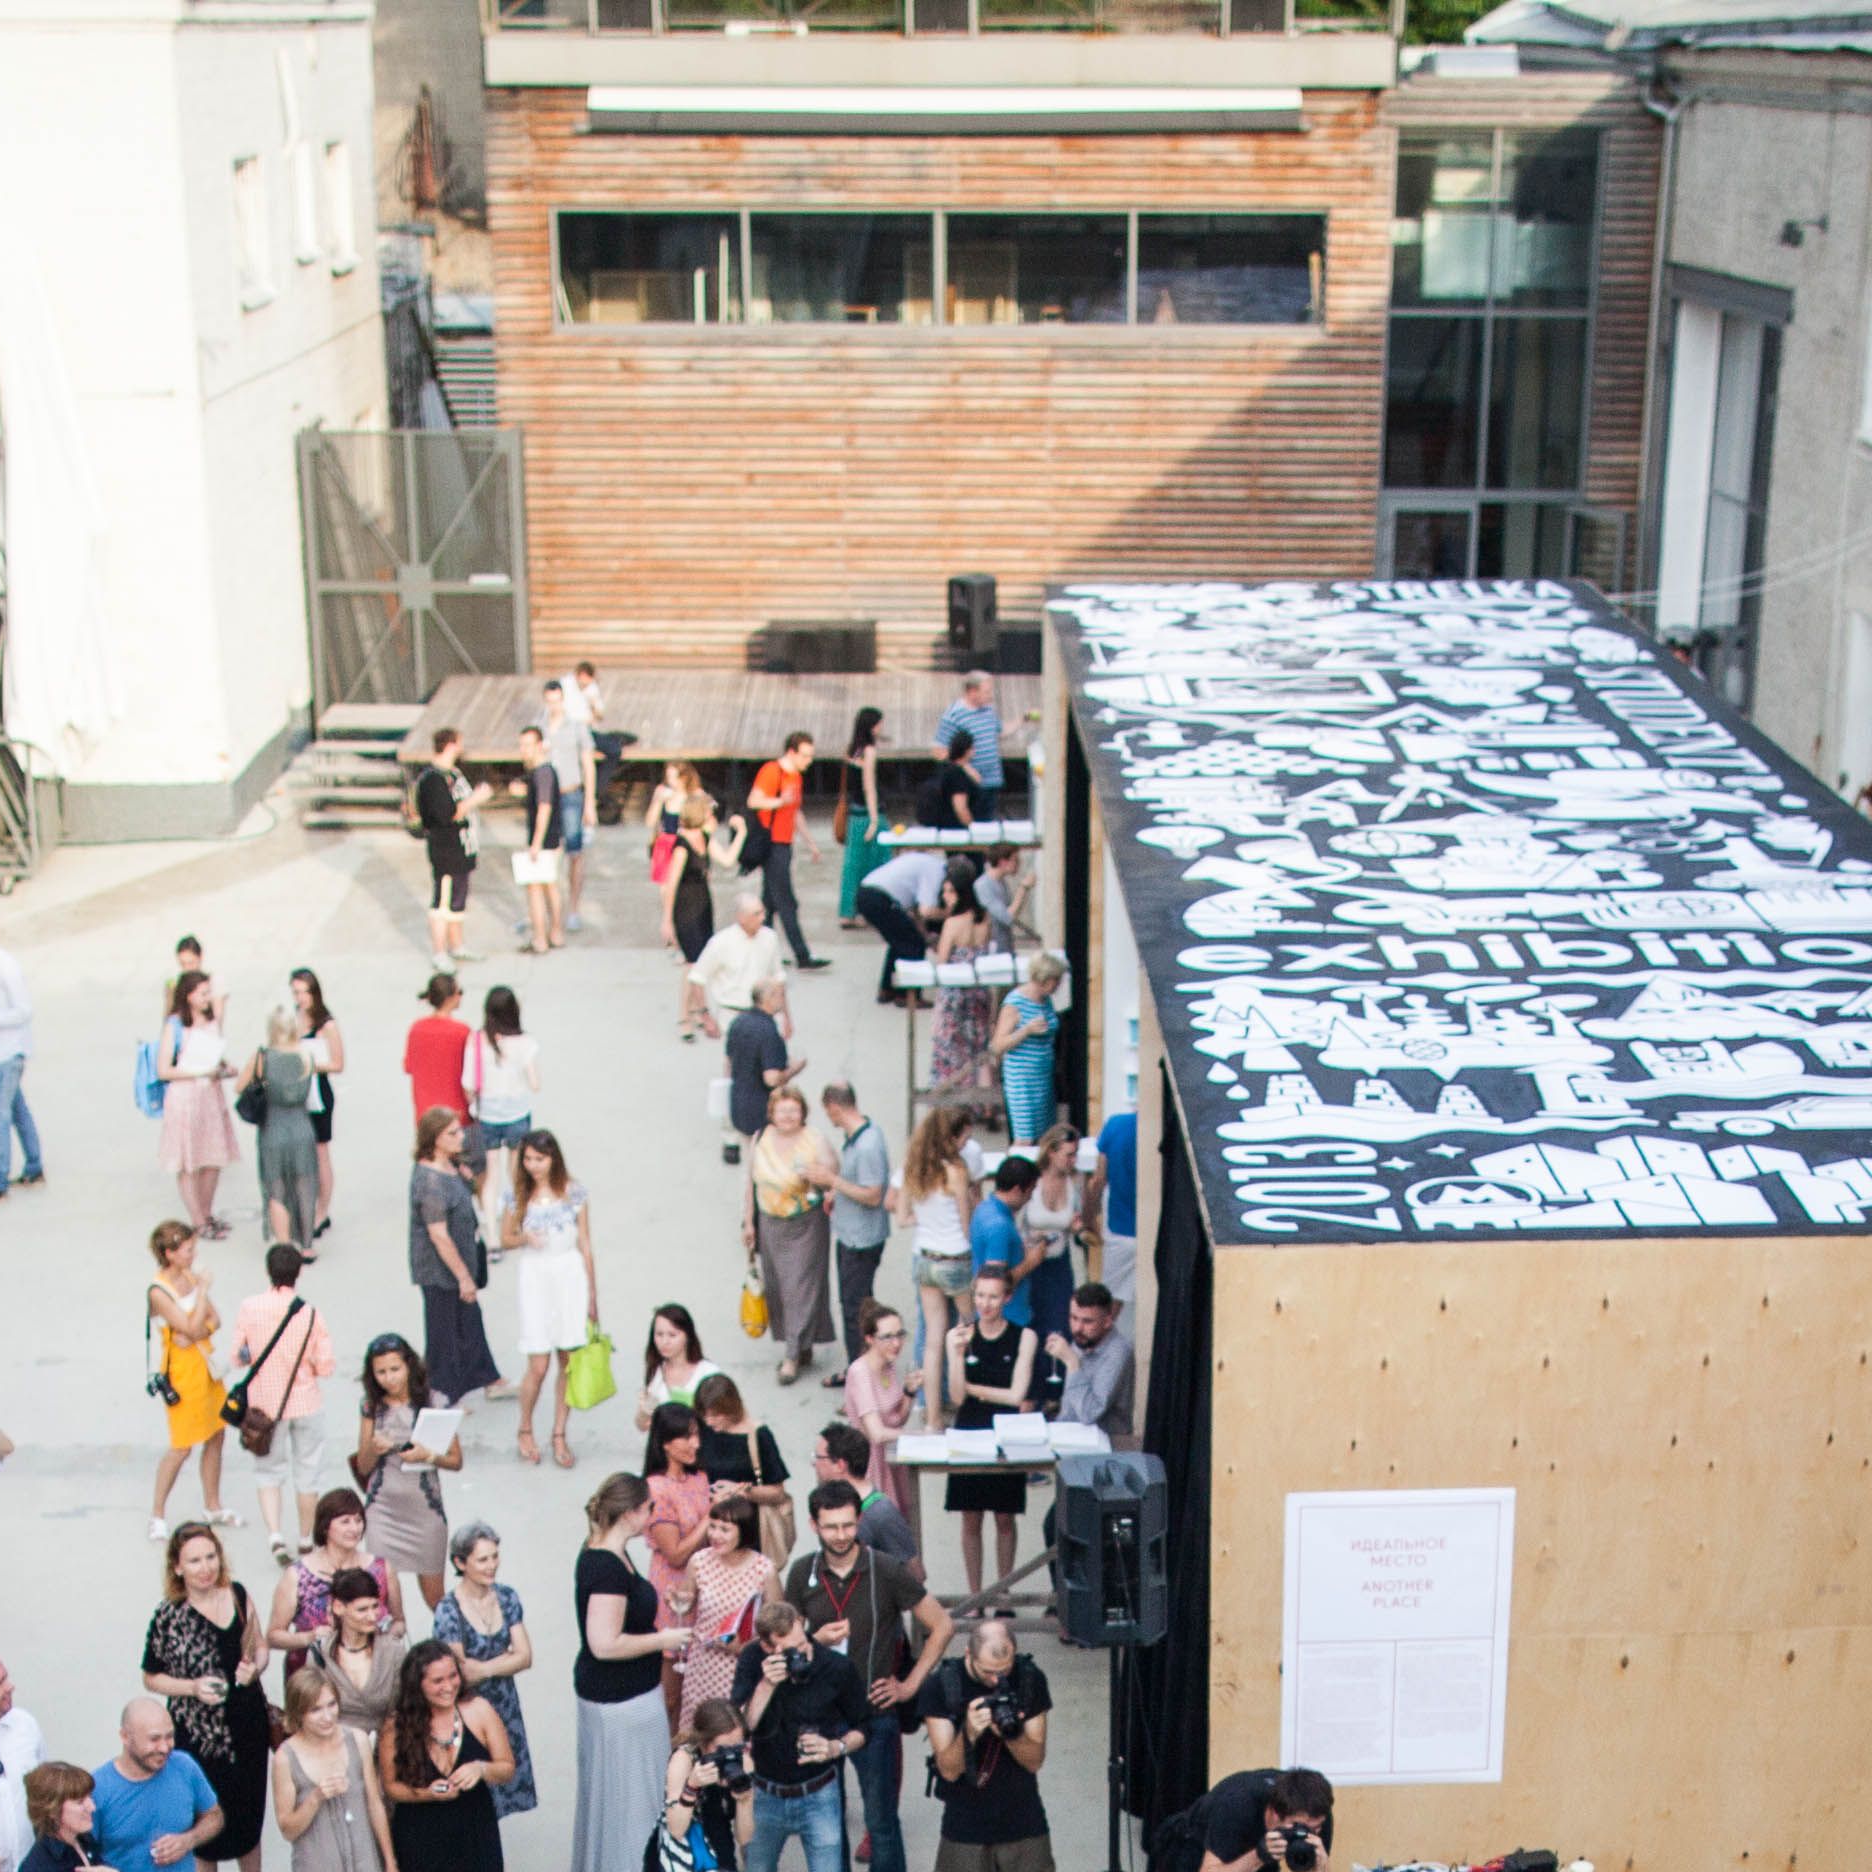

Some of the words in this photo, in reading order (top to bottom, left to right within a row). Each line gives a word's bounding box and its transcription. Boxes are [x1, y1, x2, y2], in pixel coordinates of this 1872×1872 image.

[1331, 579, 1574, 601] STRELKA
[1221, 1142, 1402, 1232] 2013
[1350, 1537, 1447, 1552] ИДЕАЛЬНОЕ
[1369, 1554, 1426, 1567] МЕСТО
[1361, 1580, 1434, 1593] ANOTHER
[1372, 1596, 1421, 1609] PLACE
